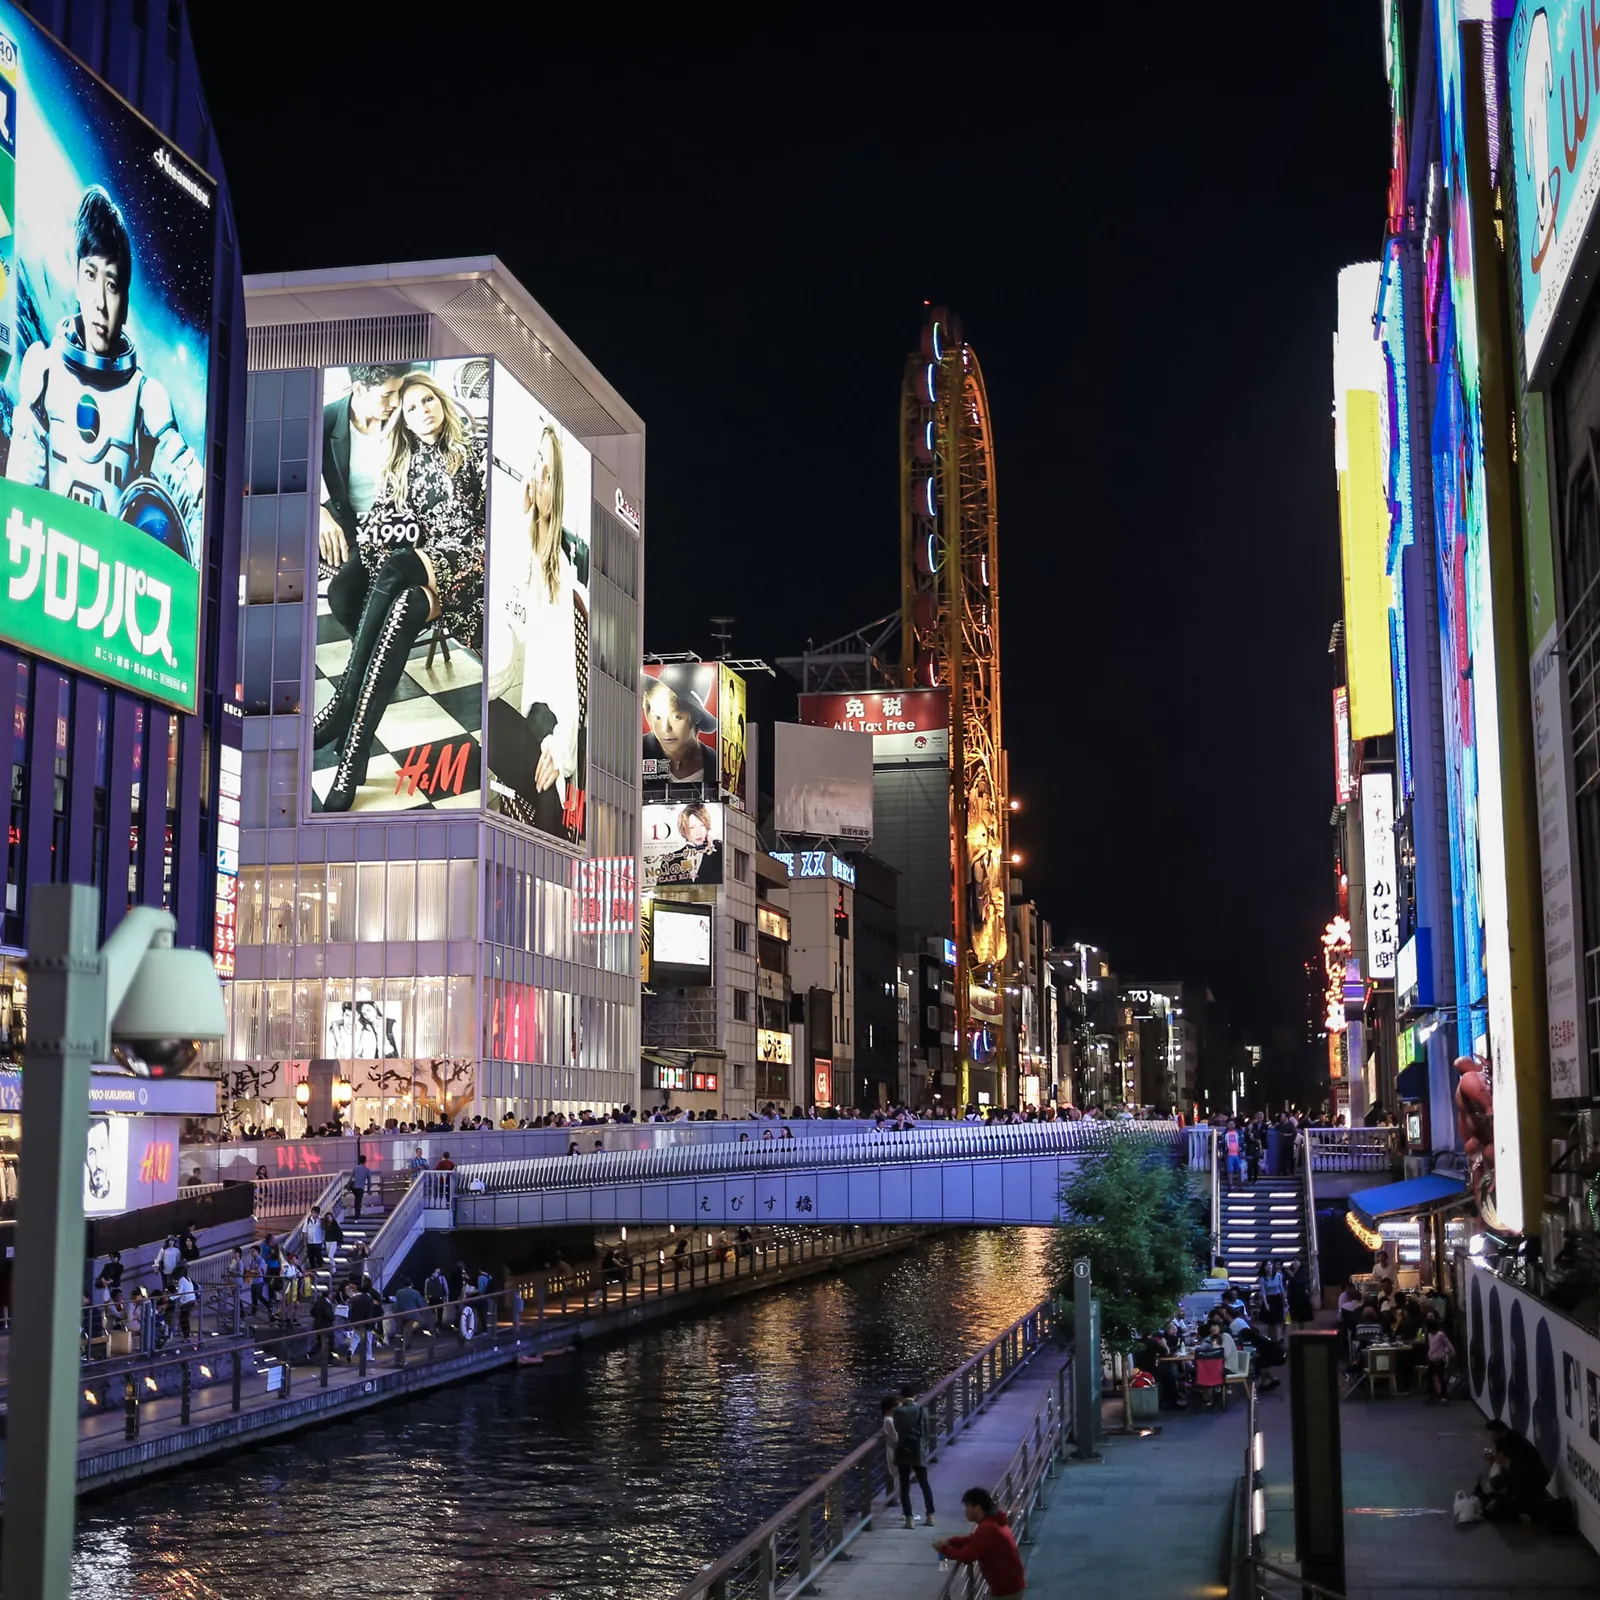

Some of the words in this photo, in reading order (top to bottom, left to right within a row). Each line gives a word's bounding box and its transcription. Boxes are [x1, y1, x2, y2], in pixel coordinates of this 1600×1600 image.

[356, 508, 416, 524] ワンピース
[6, 507, 173, 668] サロンパス
[845, 697, 903, 718] 免税
[859, 720, 882, 733] Tax
[886, 719, 916, 731] Free
[394, 742, 471, 797] H&M
[700, 1195, 813, 1213] えびす橋
